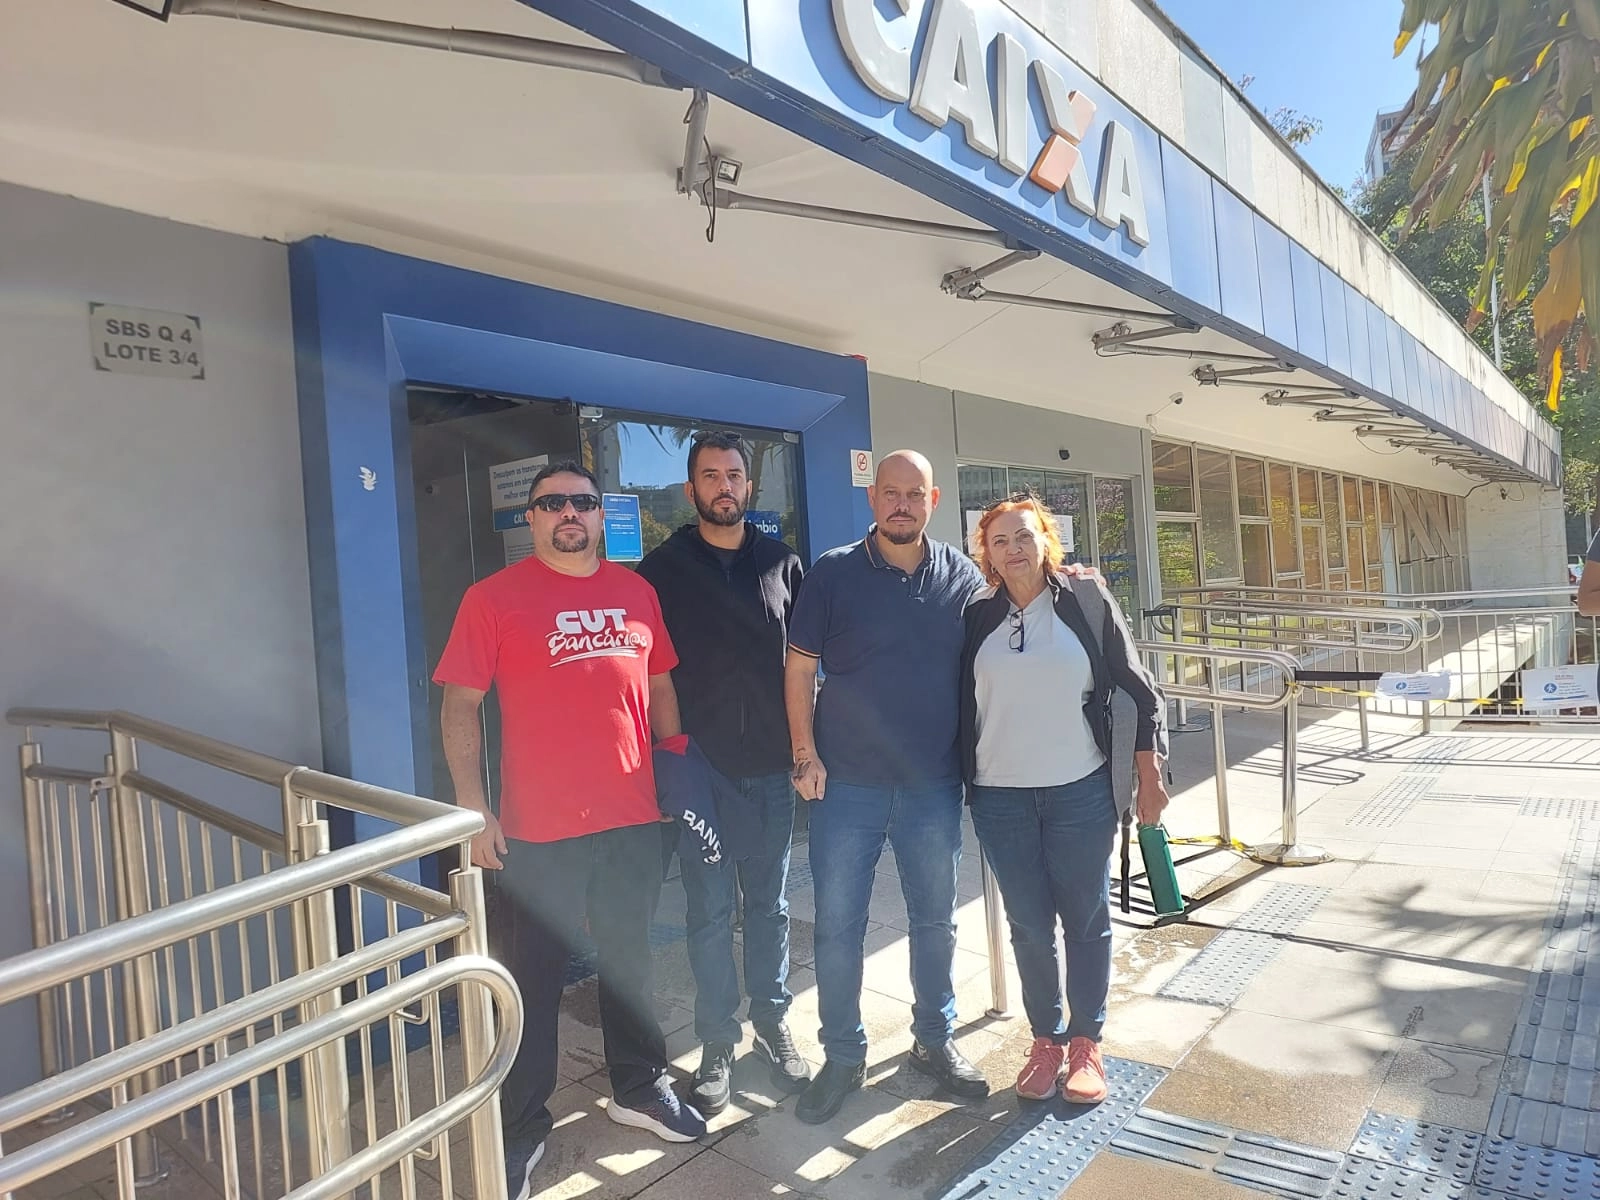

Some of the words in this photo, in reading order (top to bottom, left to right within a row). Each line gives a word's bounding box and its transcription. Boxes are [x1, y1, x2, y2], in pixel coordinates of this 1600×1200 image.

[831, 0, 1150, 247] CAIXA
[106, 318, 150, 338] SBS
[158, 326, 174, 343] Q
[180, 328, 192, 344] 4
[104, 341, 163, 363] LOTE
[169, 349, 199, 367] 3/4
[513, 512, 525, 524] CAI
[754, 519, 778, 534] mbio
[555, 608, 627, 634] CUT
[545, 627, 647, 656] Bancári@s
